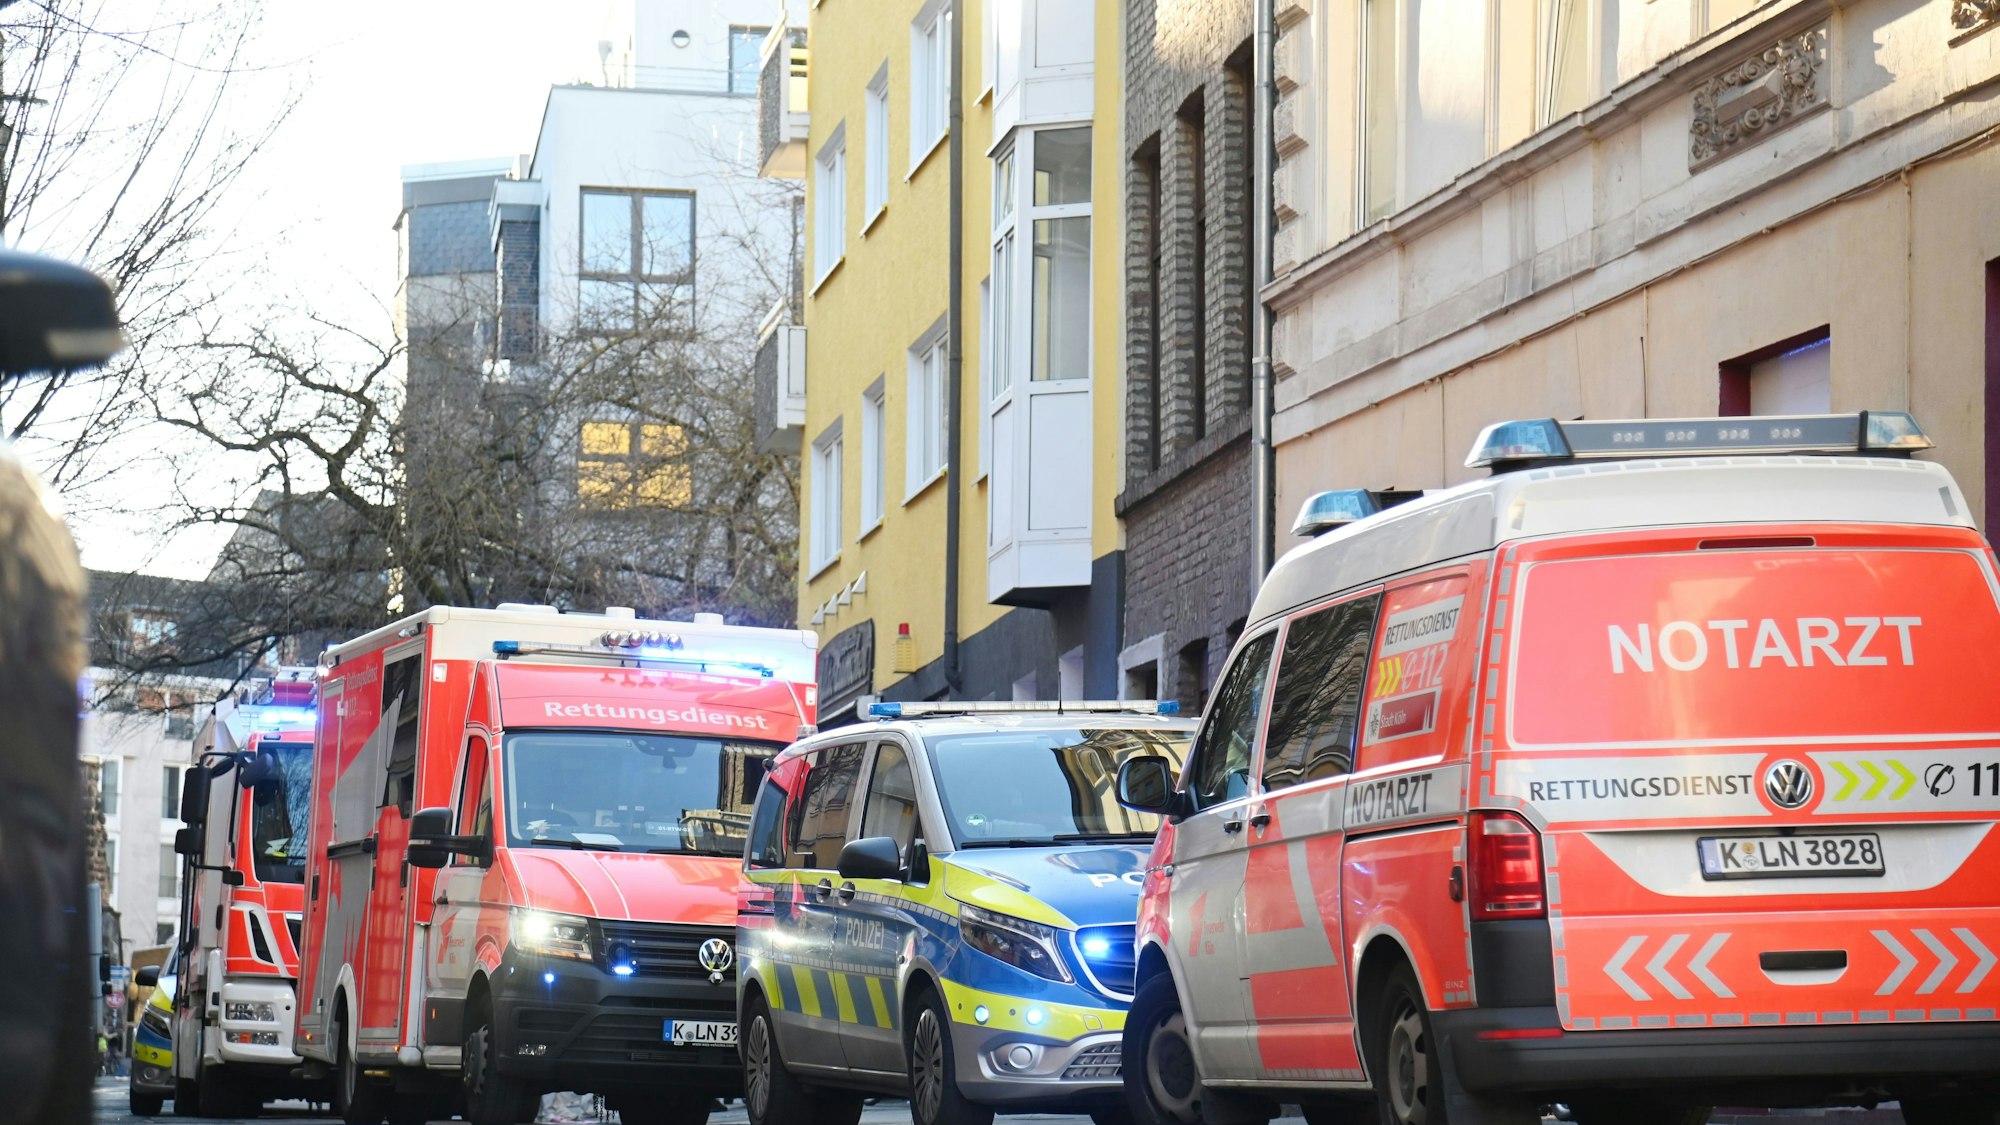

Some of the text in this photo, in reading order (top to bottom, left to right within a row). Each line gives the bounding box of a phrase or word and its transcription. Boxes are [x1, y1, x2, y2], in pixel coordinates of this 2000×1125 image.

[1384, 608, 1460, 646] RETTUNGSDIENST
[1607, 616, 1923, 674] NOTARZT
[1418, 643, 1449, 689] 112
[543, 701, 769, 730] Rettungsdienst
[1380, 711, 1394, 728] Stadt
[1529, 774, 1753, 801] RETTUNGSDIENST
[1967, 763, 2000, 796] 11
[1351, 773, 1433, 824] NOTARZT
[1720, 842, 1741, 869] K
[1759, 840, 1800, 867] LN
[1803, 838, 1877, 866] 3828
[845, 917, 885, 950] POLIZEI
[1445, 980, 1464, 989] BINZ
[674, 1023, 685, 1039] K
[695, 1024, 718, 1041] LN
